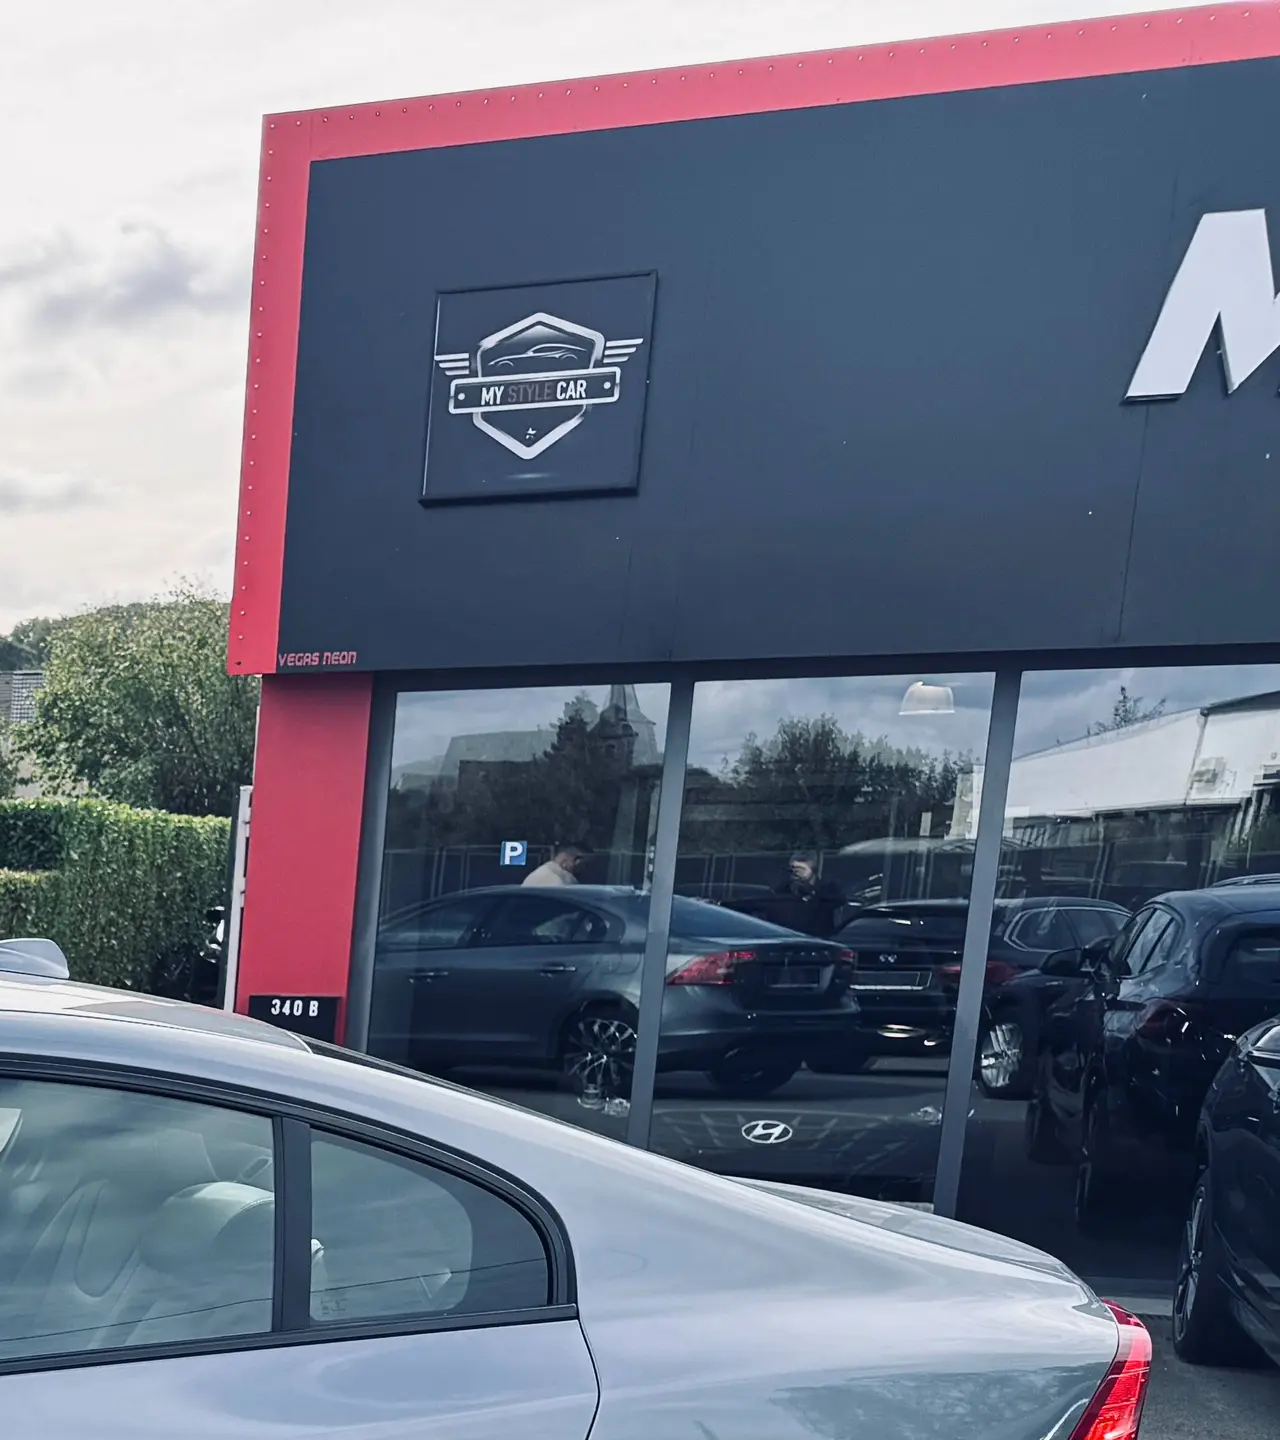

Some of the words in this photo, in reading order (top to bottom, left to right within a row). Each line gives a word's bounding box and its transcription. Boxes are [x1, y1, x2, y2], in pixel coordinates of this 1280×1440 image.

[481, 385, 504, 406] MY
[508, 381, 554, 402] STYLE
[557, 379, 587, 400] CAR
[278, 652, 320, 667] VEGAS
[323, 651, 357, 665] NEON
[504, 841, 523, 865] P
[271, 999, 303, 1016] 340
[309, 1000, 319, 1017] B
